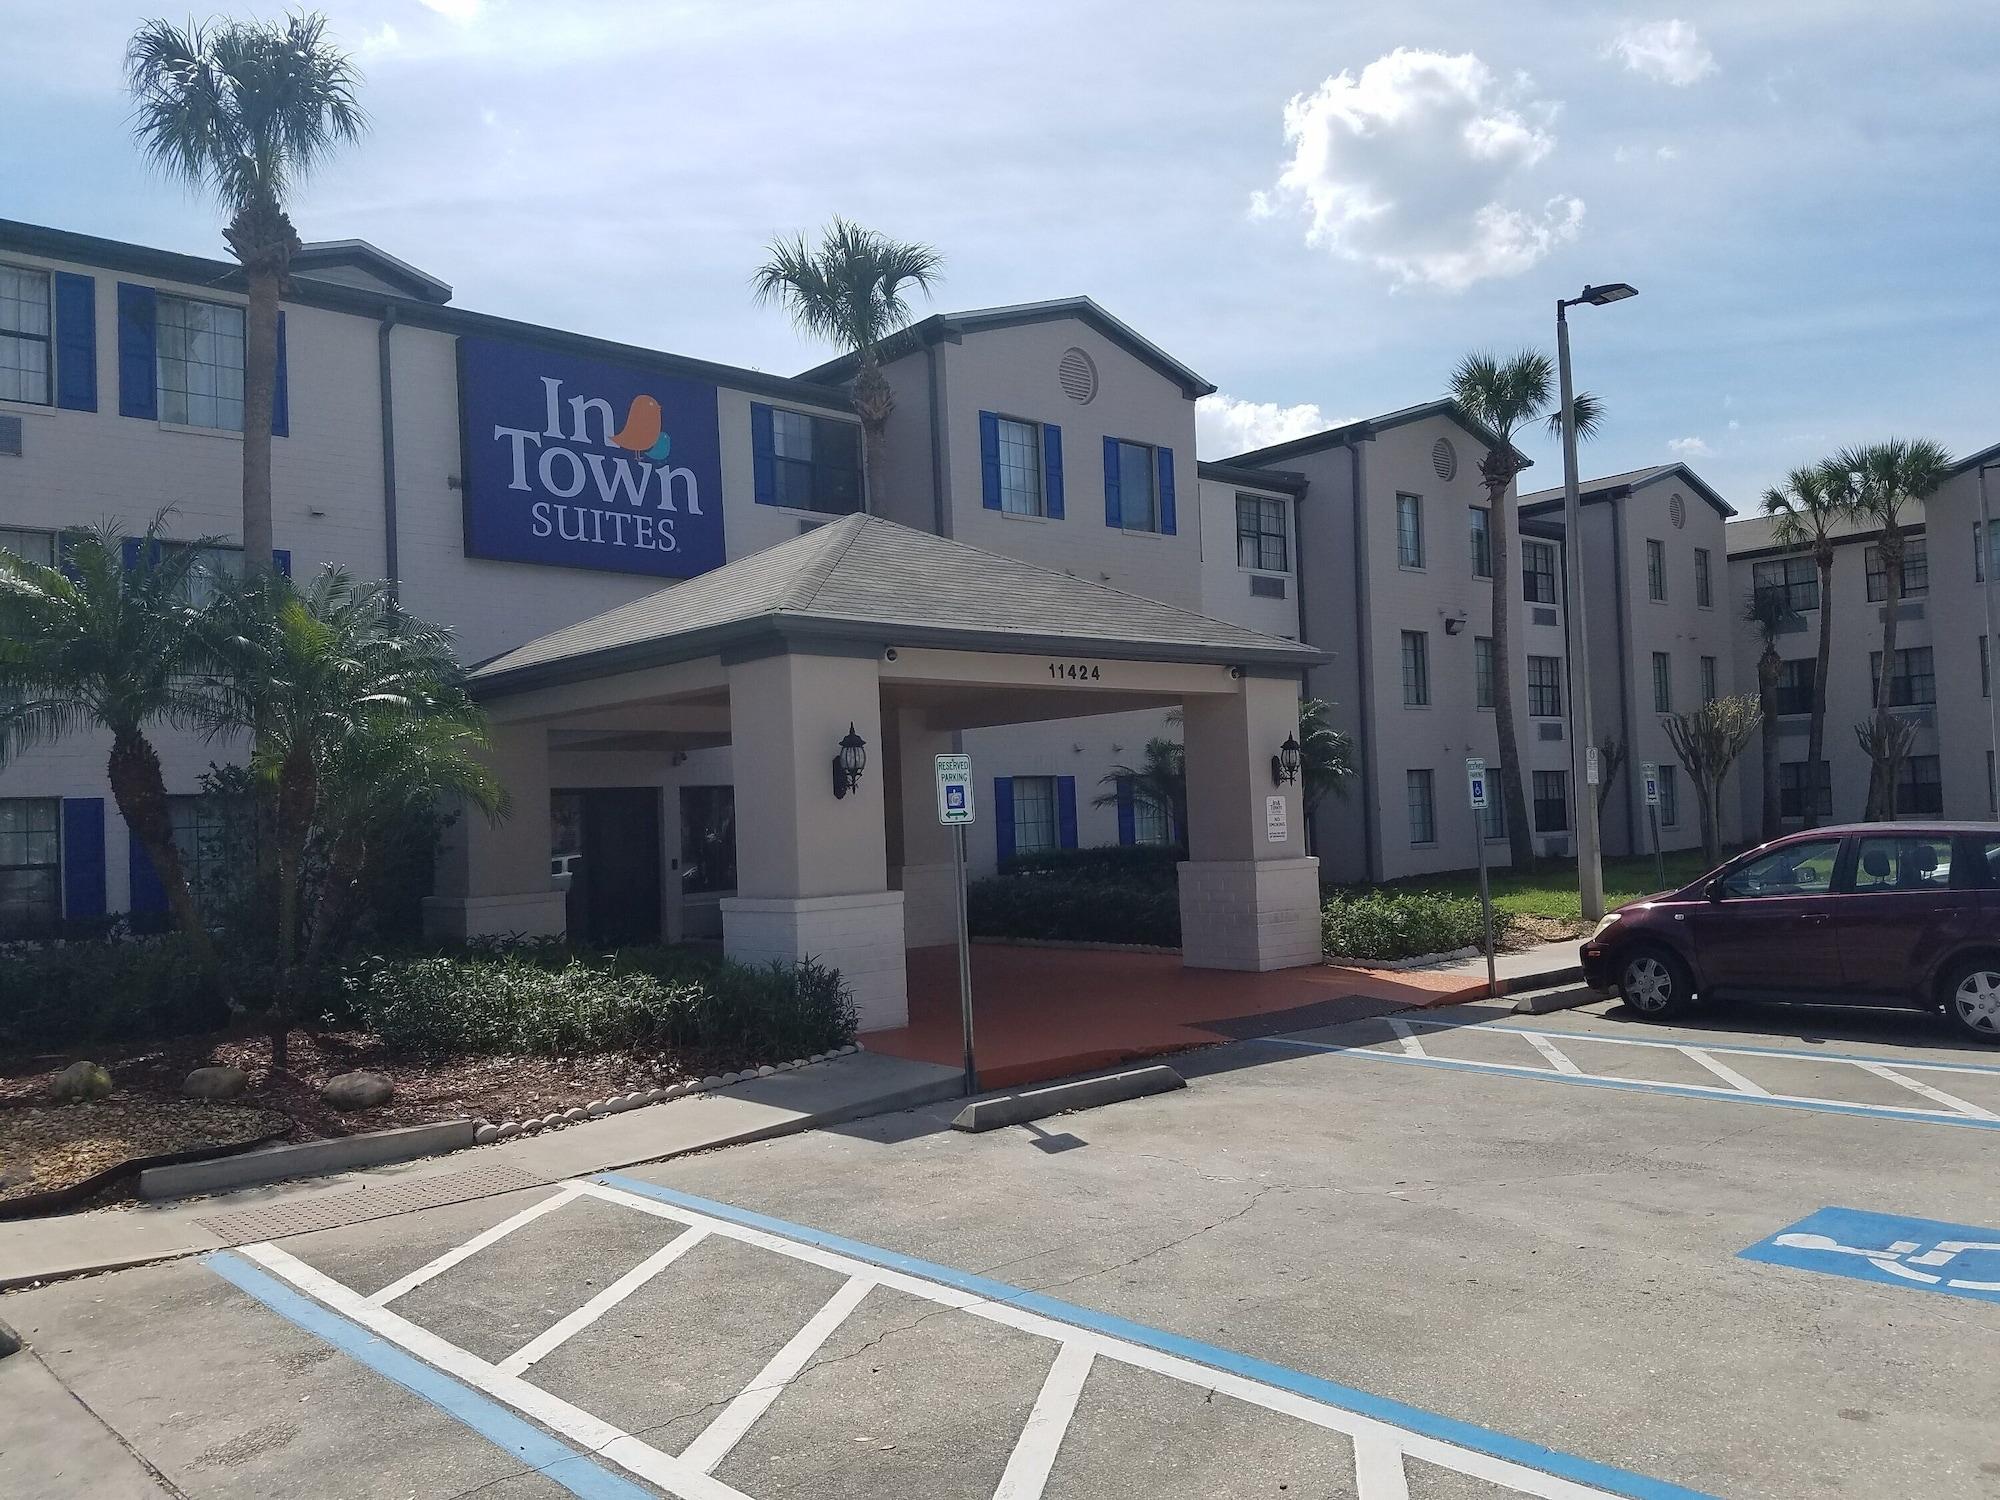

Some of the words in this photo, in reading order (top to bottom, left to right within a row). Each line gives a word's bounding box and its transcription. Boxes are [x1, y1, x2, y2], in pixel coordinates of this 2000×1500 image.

[540, 376, 620, 448] In
[494, 424, 703, 516] Town
[532, 502, 677, 552] SUITES
[1049, 663, 1100, 681] 11424
[938, 761, 968, 770] RESERVED
[941, 773, 968, 782] PARKING
